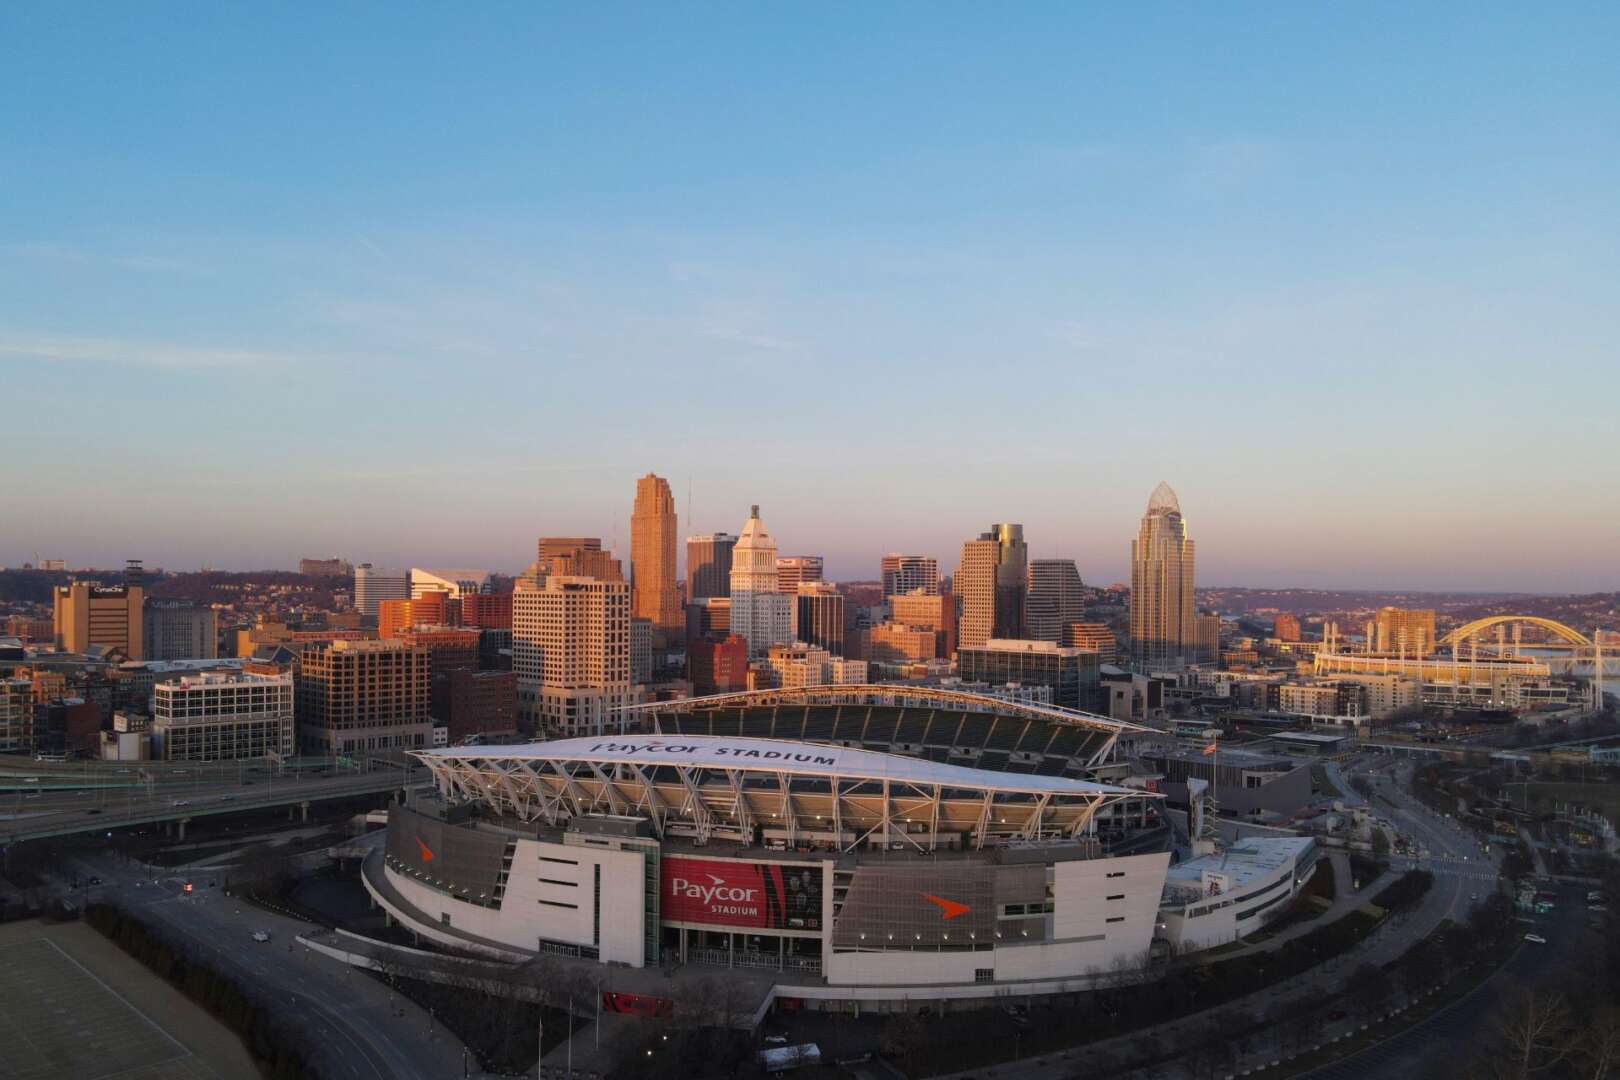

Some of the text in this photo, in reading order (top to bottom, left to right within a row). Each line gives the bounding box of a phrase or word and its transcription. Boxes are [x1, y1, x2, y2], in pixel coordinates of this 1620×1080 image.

[590, 743, 835, 766] Paycor STADIUM
[672, 878, 758, 904] Paycor
[711, 905, 758, 916] STADIUM
